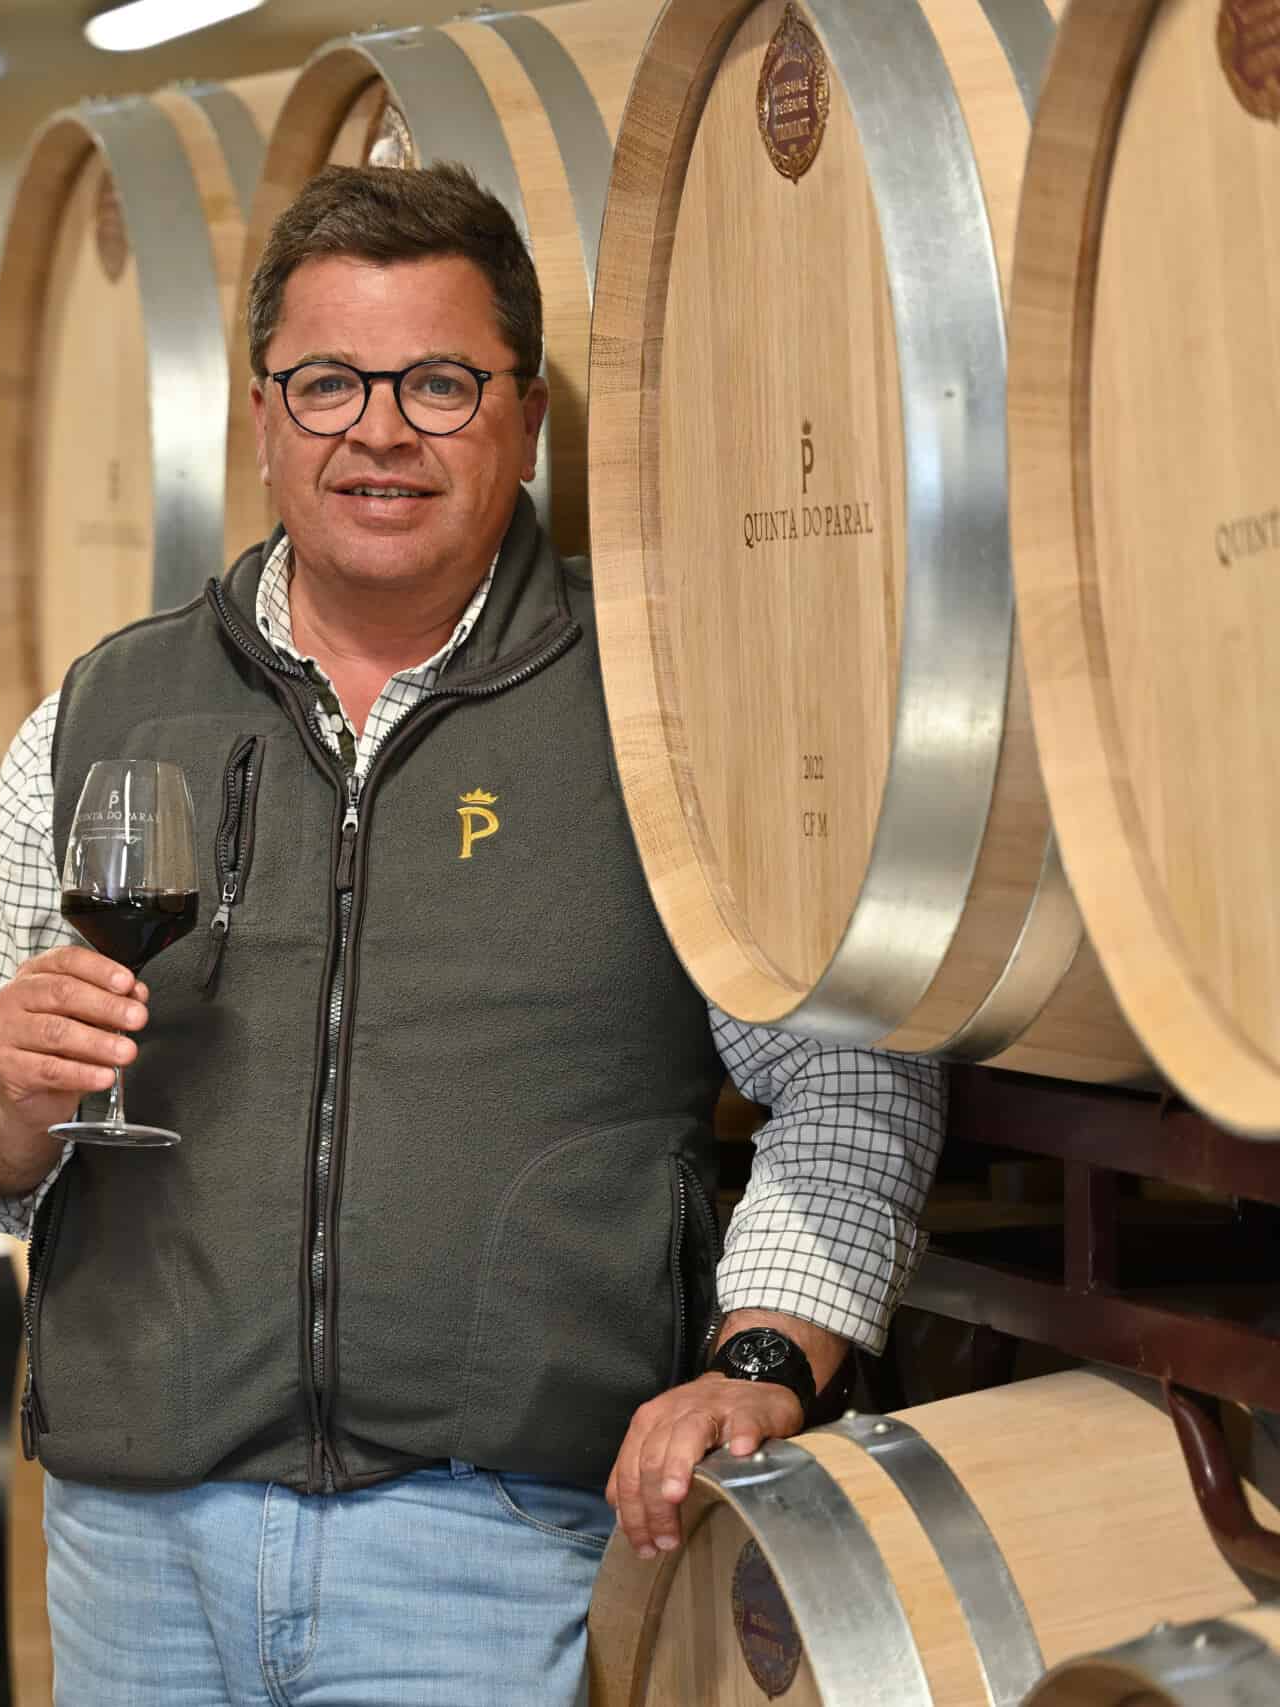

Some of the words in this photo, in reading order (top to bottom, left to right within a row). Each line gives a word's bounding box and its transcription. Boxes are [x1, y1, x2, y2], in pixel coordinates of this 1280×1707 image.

[744, 510, 799, 549] QUINTA
[802, 506, 822, 537] DO
[824, 502, 873, 537] PARAL
[106, 810, 122, 821] DO
